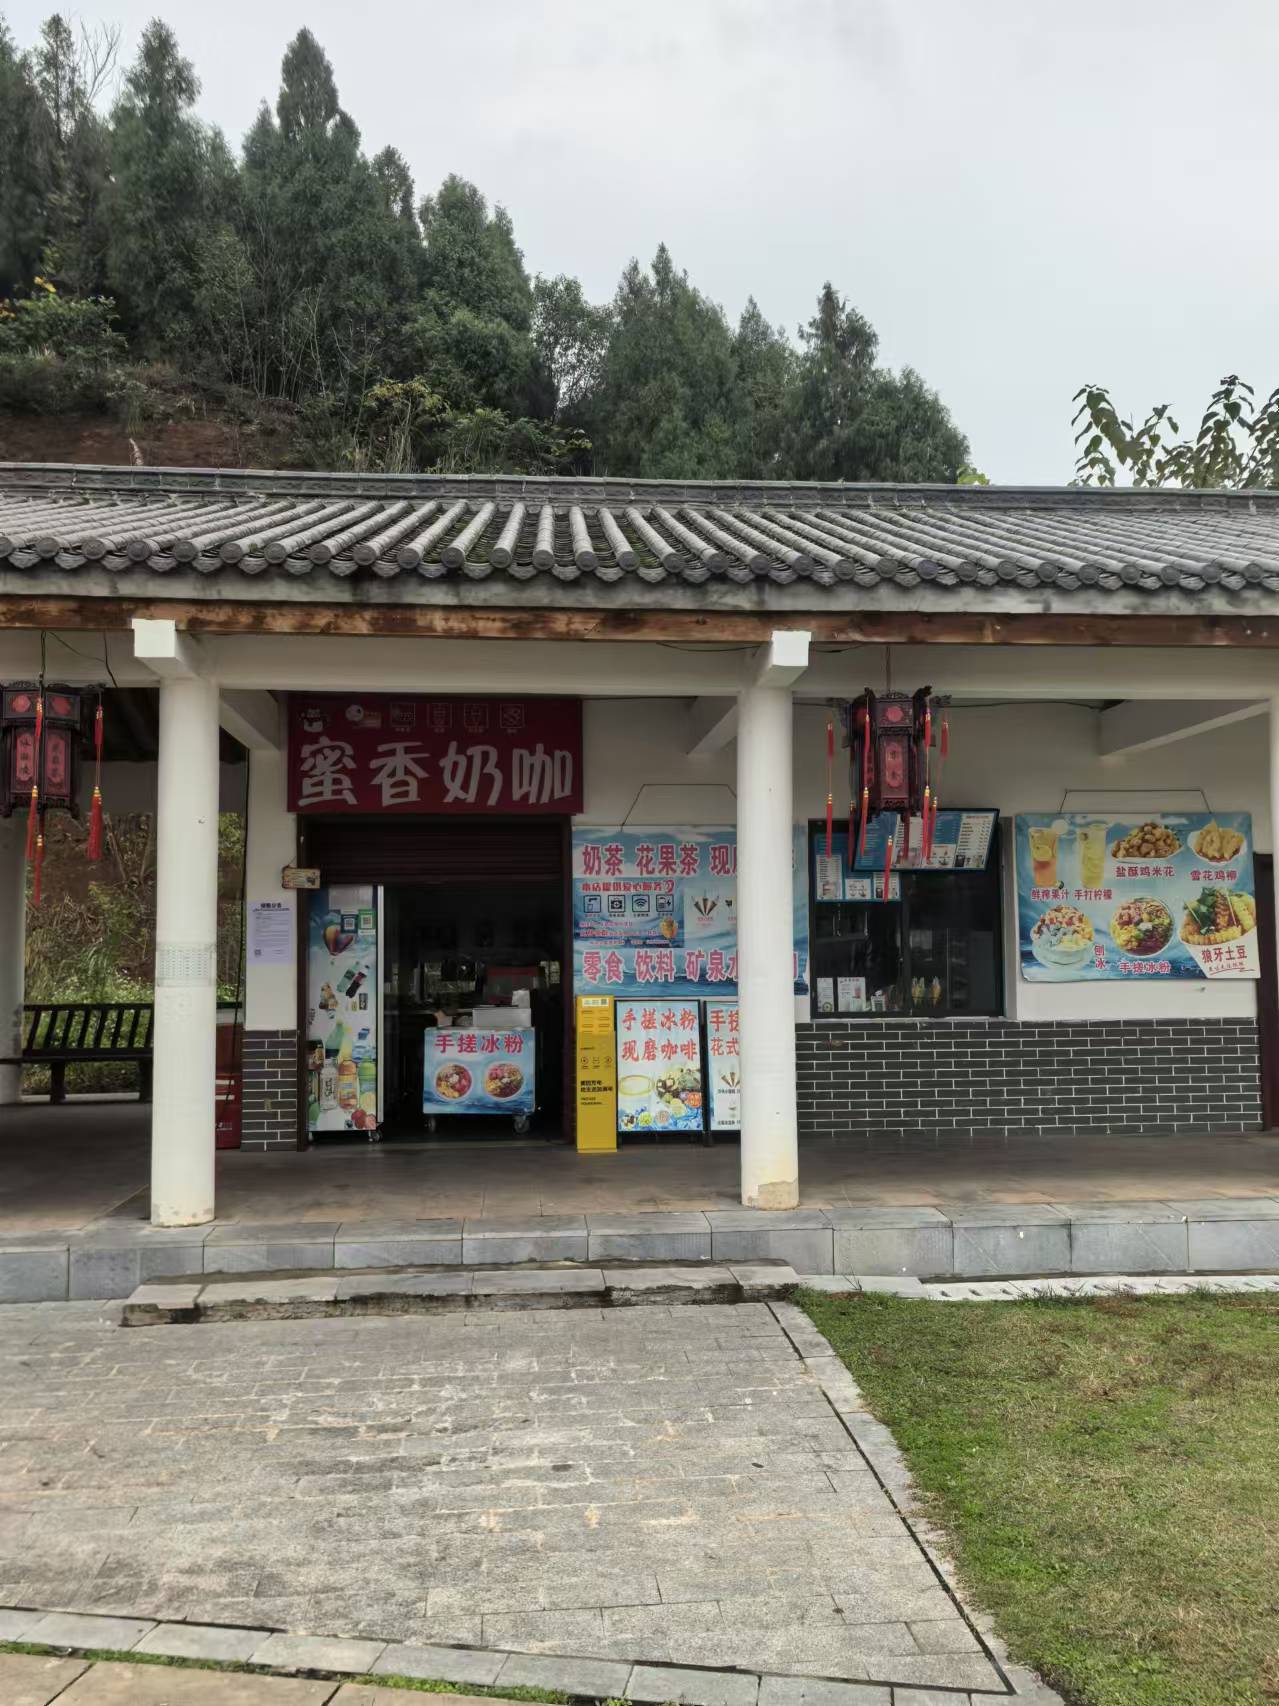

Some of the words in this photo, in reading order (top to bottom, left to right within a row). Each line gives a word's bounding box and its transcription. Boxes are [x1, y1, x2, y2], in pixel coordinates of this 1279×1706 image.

[298, 736, 573, 807] 蜜香奶咖
[582, 844, 624, 876] 奶茶
[635, 844, 699, 876] 花果茶
[710, 844, 737, 876] 现
[1115, 865, 1176, 878] 盐酥鸡米花
[1189, 869, 1238, 882] 雪花鸡柳
[1031, 887, 1070, 901] 鲜榨果汁
[1074, 888, 1113, 901] 手打柠檬
[1201, 943, 1248, 964] 狼牙土豆
[582, 950, 624, 982] 零食
[635, 950, 675, 982] 饮料
[1119, 960, 1172, 974] 手搓冰粉
[621, 1007, 697, 1032] 手搓冰粉
[434, 1034, 524, 1054] 手搓冰粉
[621, 1037, 698, 1062] 现磨咖啡
